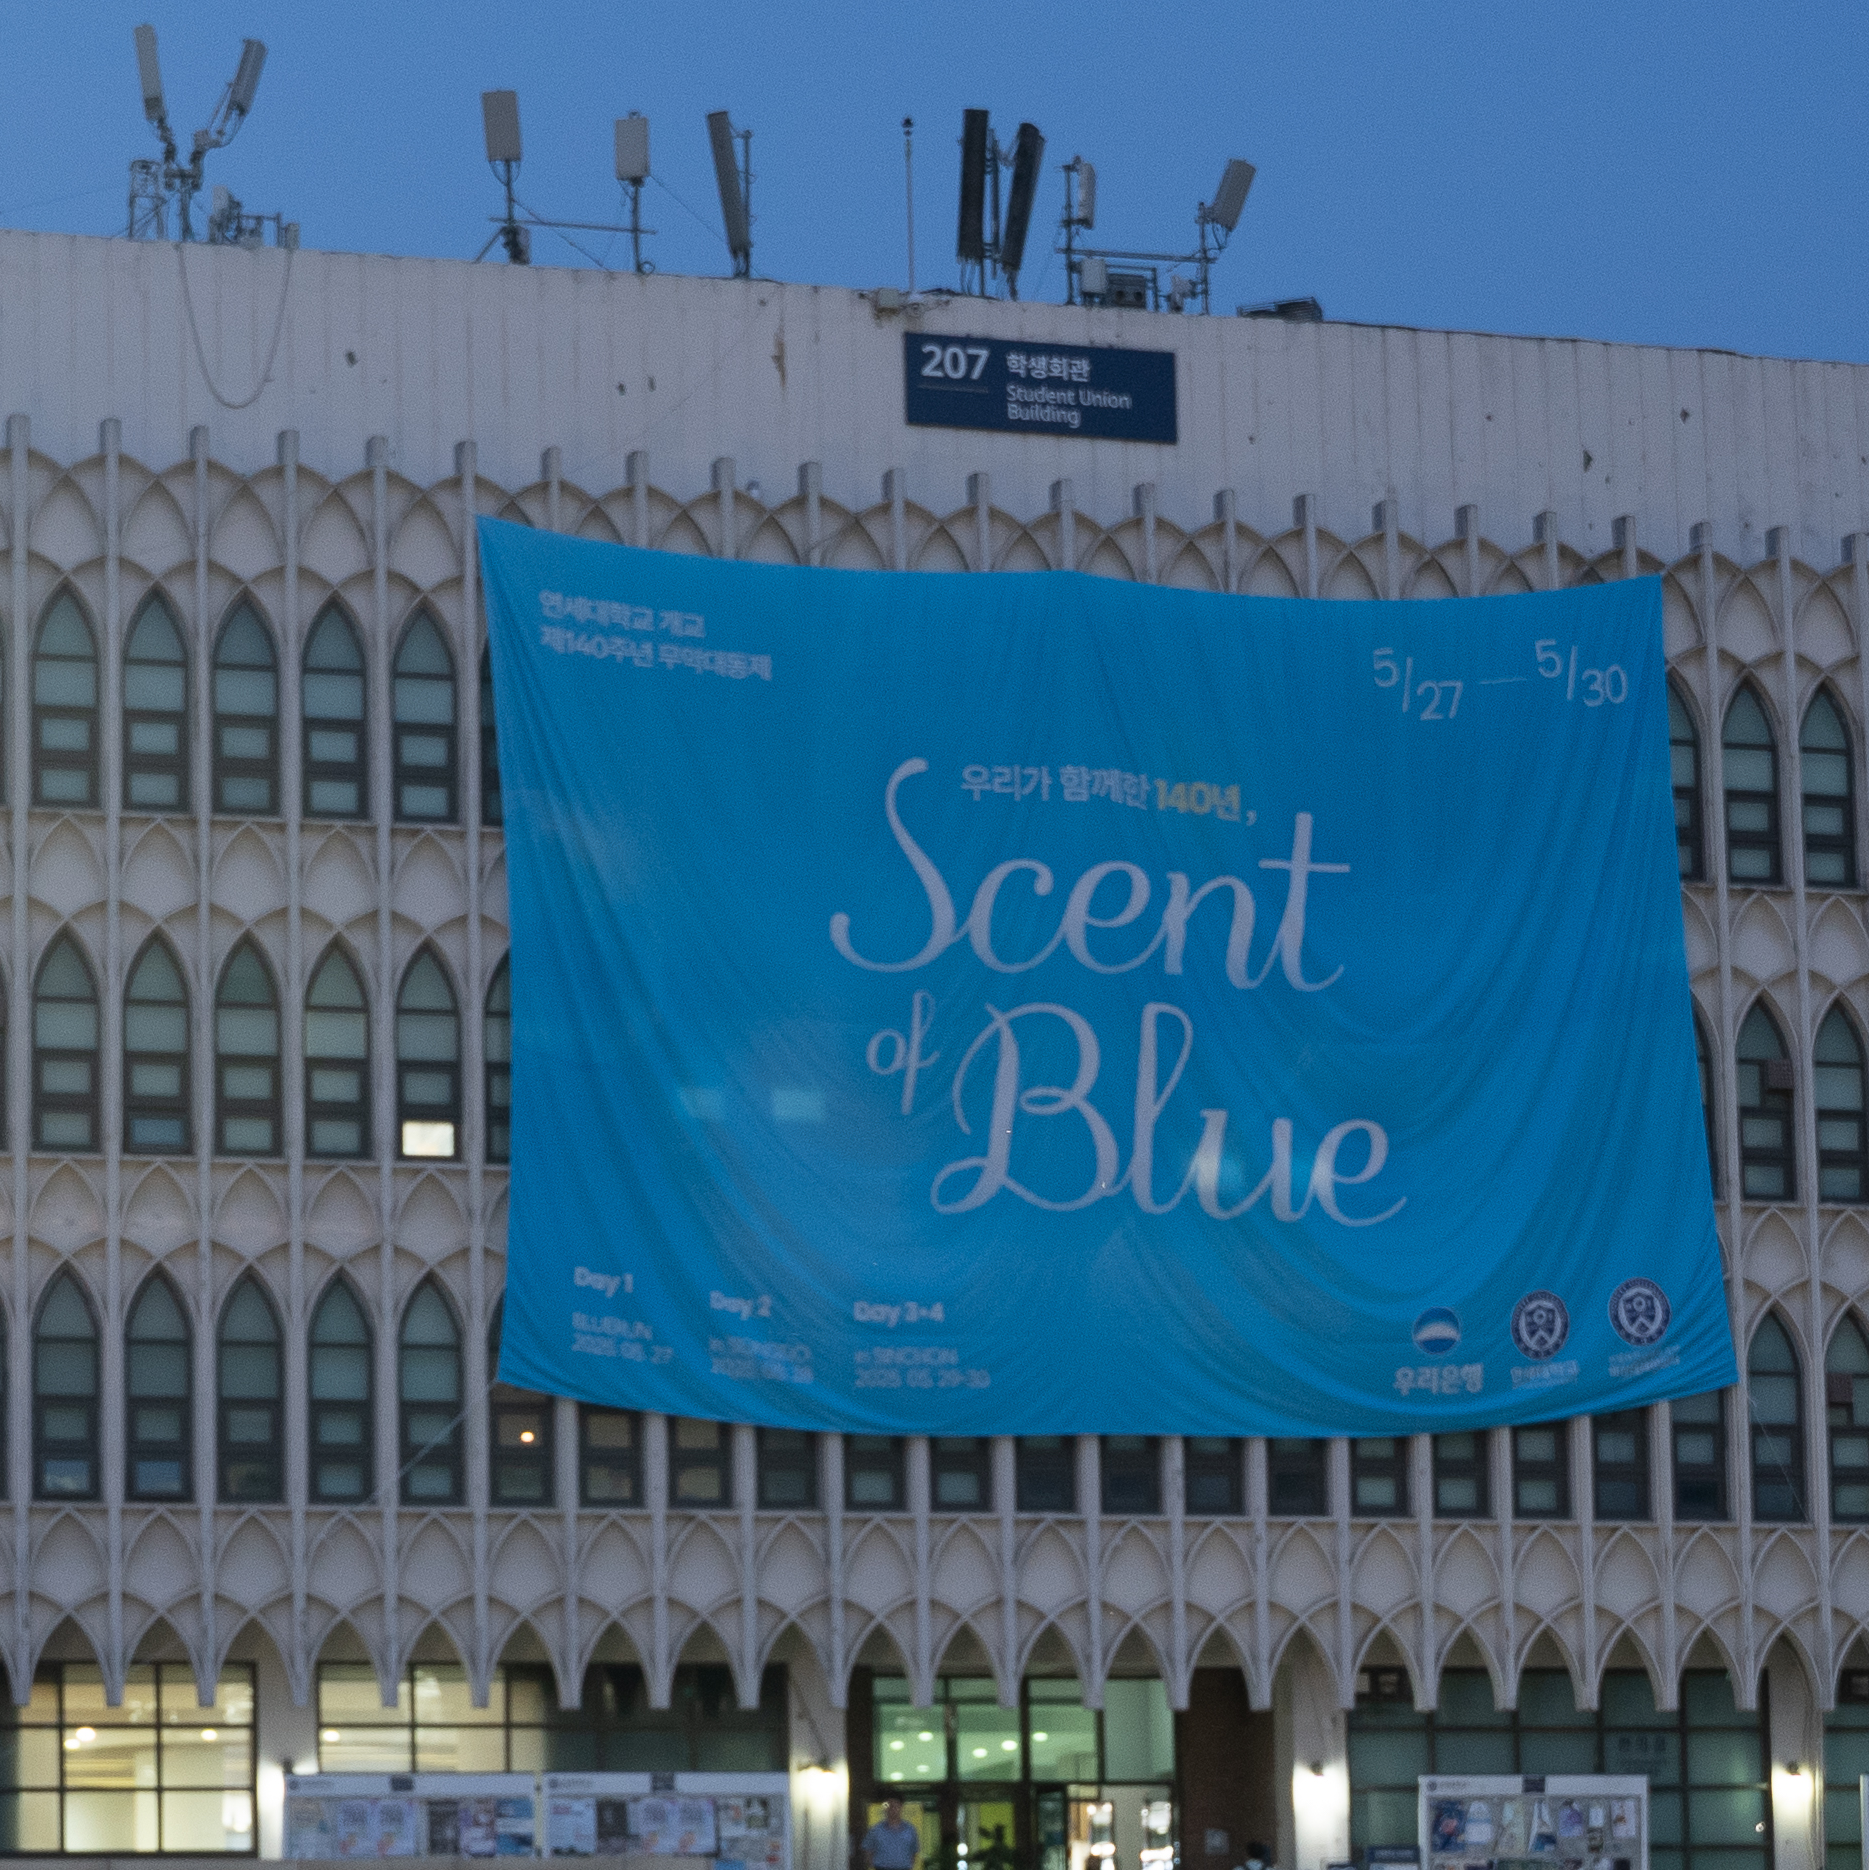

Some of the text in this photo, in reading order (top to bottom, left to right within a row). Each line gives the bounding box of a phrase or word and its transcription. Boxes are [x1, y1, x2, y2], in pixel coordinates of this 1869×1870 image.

[921, 344, 990, 381] 207
[1006, 352, 1092, 382] 학생회관
[1006, 383, 1132, 410] Student Union
[1007, 402, 1081, 428] Building
[1373, 647, 1464, 721] 5/27
[1534, 638, 1629, 708] 5/30
[960, 763, 1258, 827] 우리가 함께한 140년,
[830, 756, 1351, 992] Scent
[866, 989, 941, 1116] of
[930, 1001, 1408, 1228] Blue
[573, 1265, 622, 1300] Day
[709, 1290, 754, 1322] Day
[852, 1299, 901, 1330] Day
[1393, 1361, 1485, 1397] 우리은행
